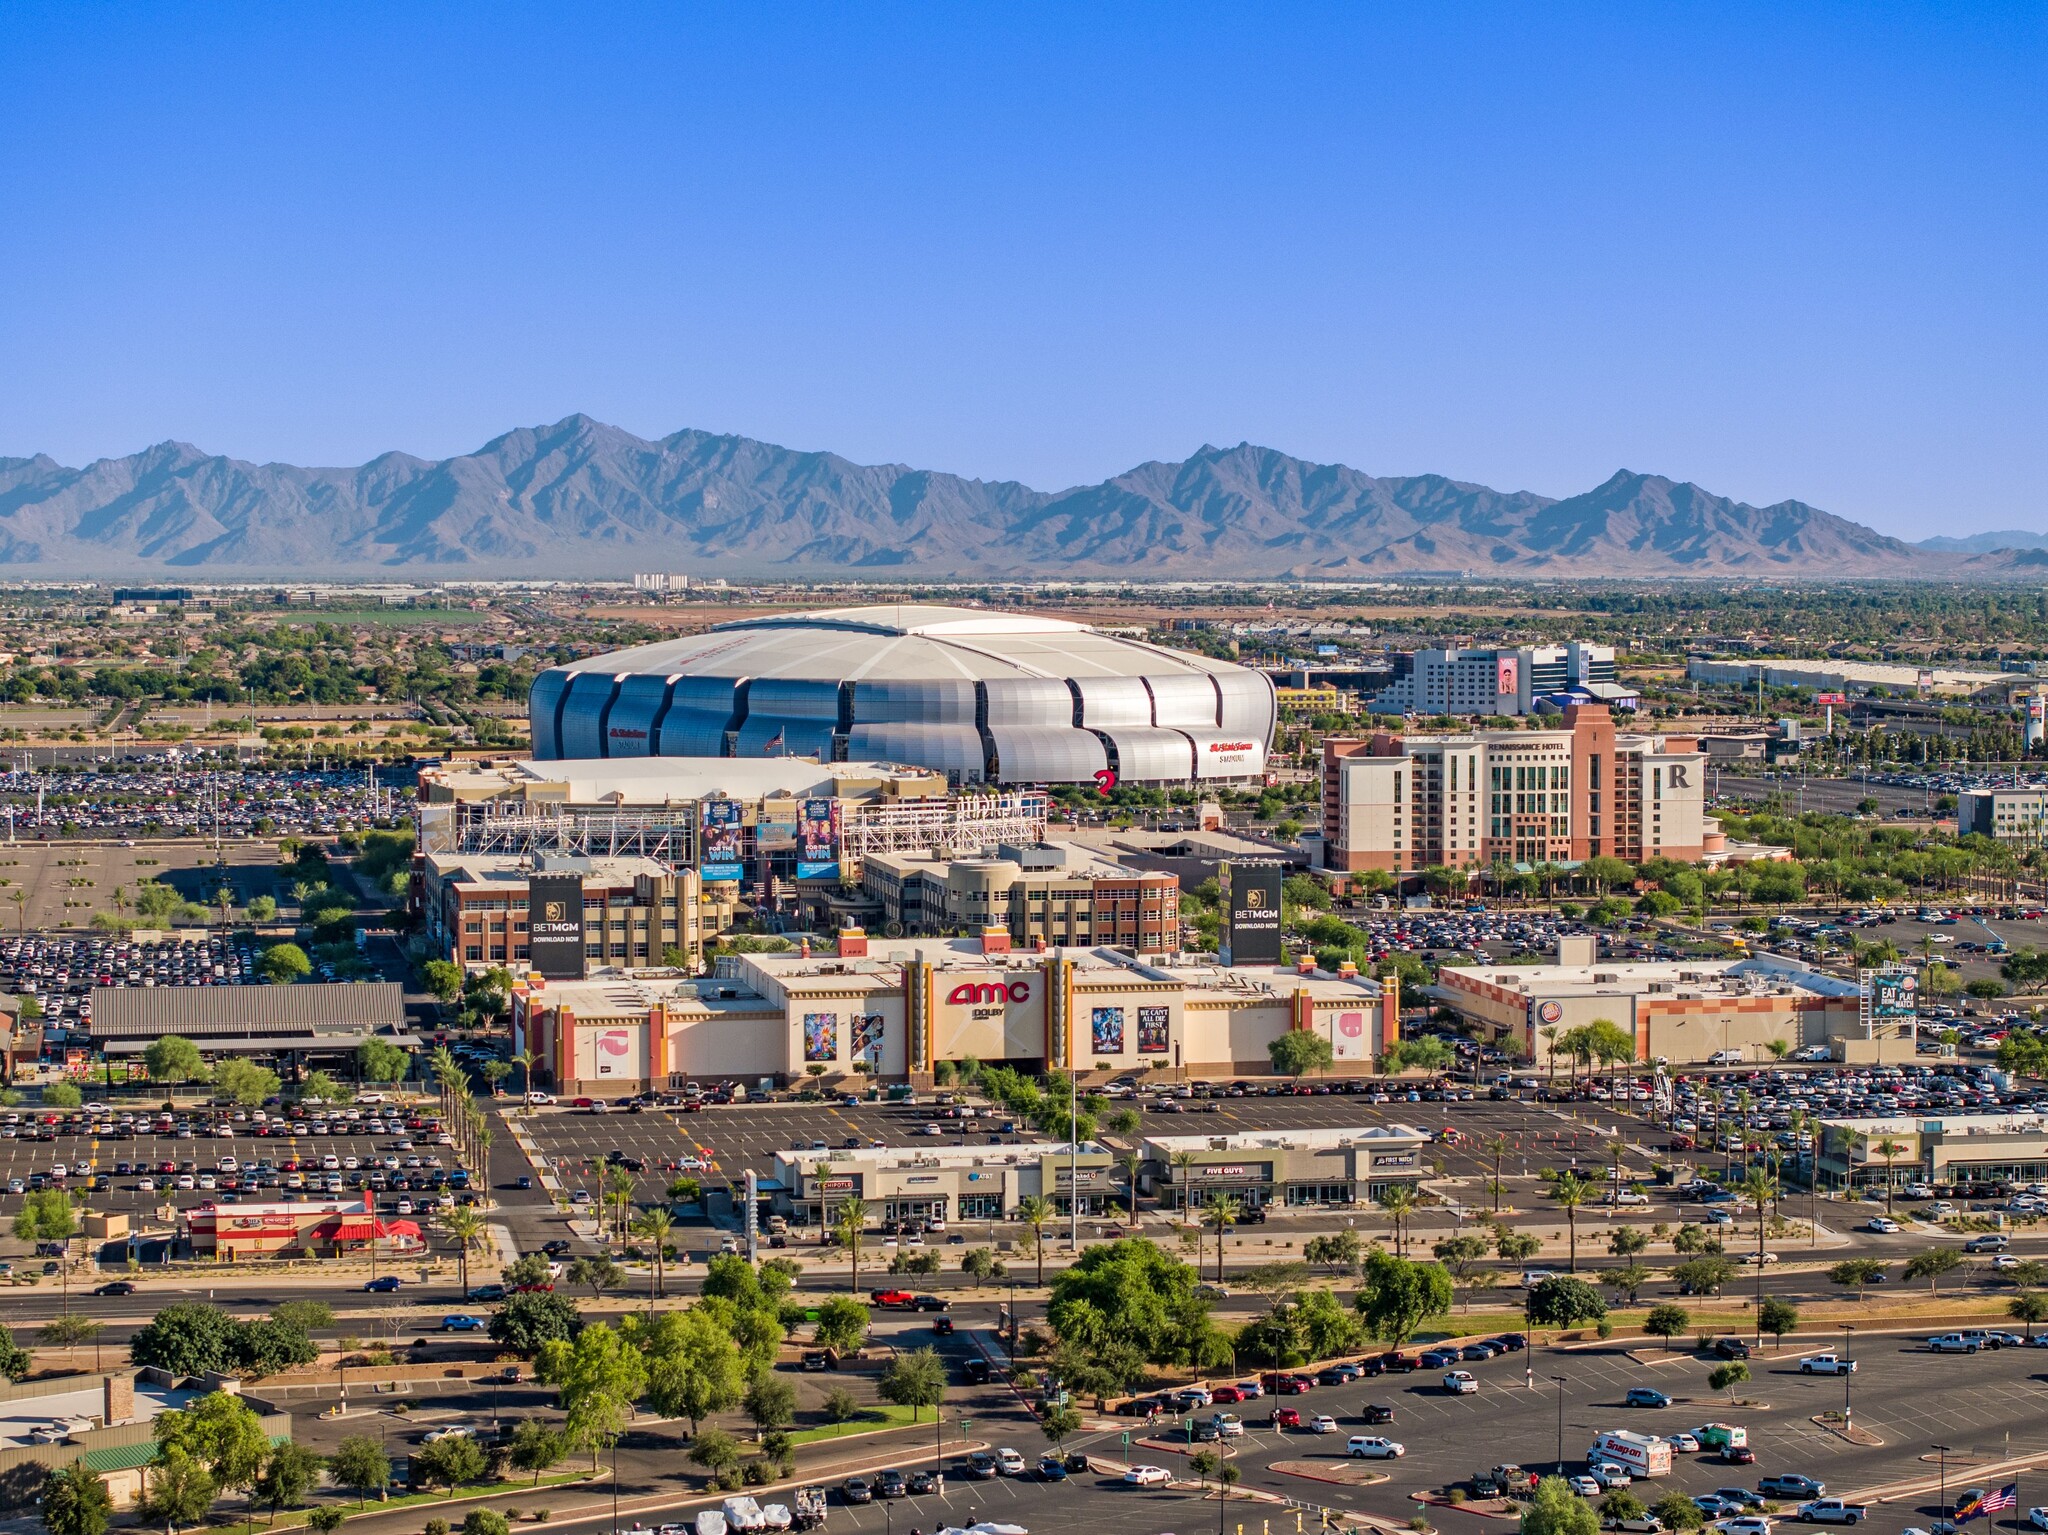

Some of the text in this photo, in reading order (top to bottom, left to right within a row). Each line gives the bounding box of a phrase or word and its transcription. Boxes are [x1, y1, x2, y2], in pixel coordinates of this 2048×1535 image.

[1488, 743, 1541, 751] RENAISSANCE
[1667, 764, 1694, 789] R
[708, 851, 735, 860] WIN
[805, 849, 831, 859] WIN
[1235, 910, 1278, 918] BETMGM
[533, 923, 579, 932] BETMGM
[1881, 987, 1896, 999] EAT
[1899, 992, 1915, 1001] PLAY
[1895, 1000, 1914, 1008] WATCH
[973, 1008, 1005, 1017] DOLBY
[1606, 1439, 1641, 1458] Snap-on
